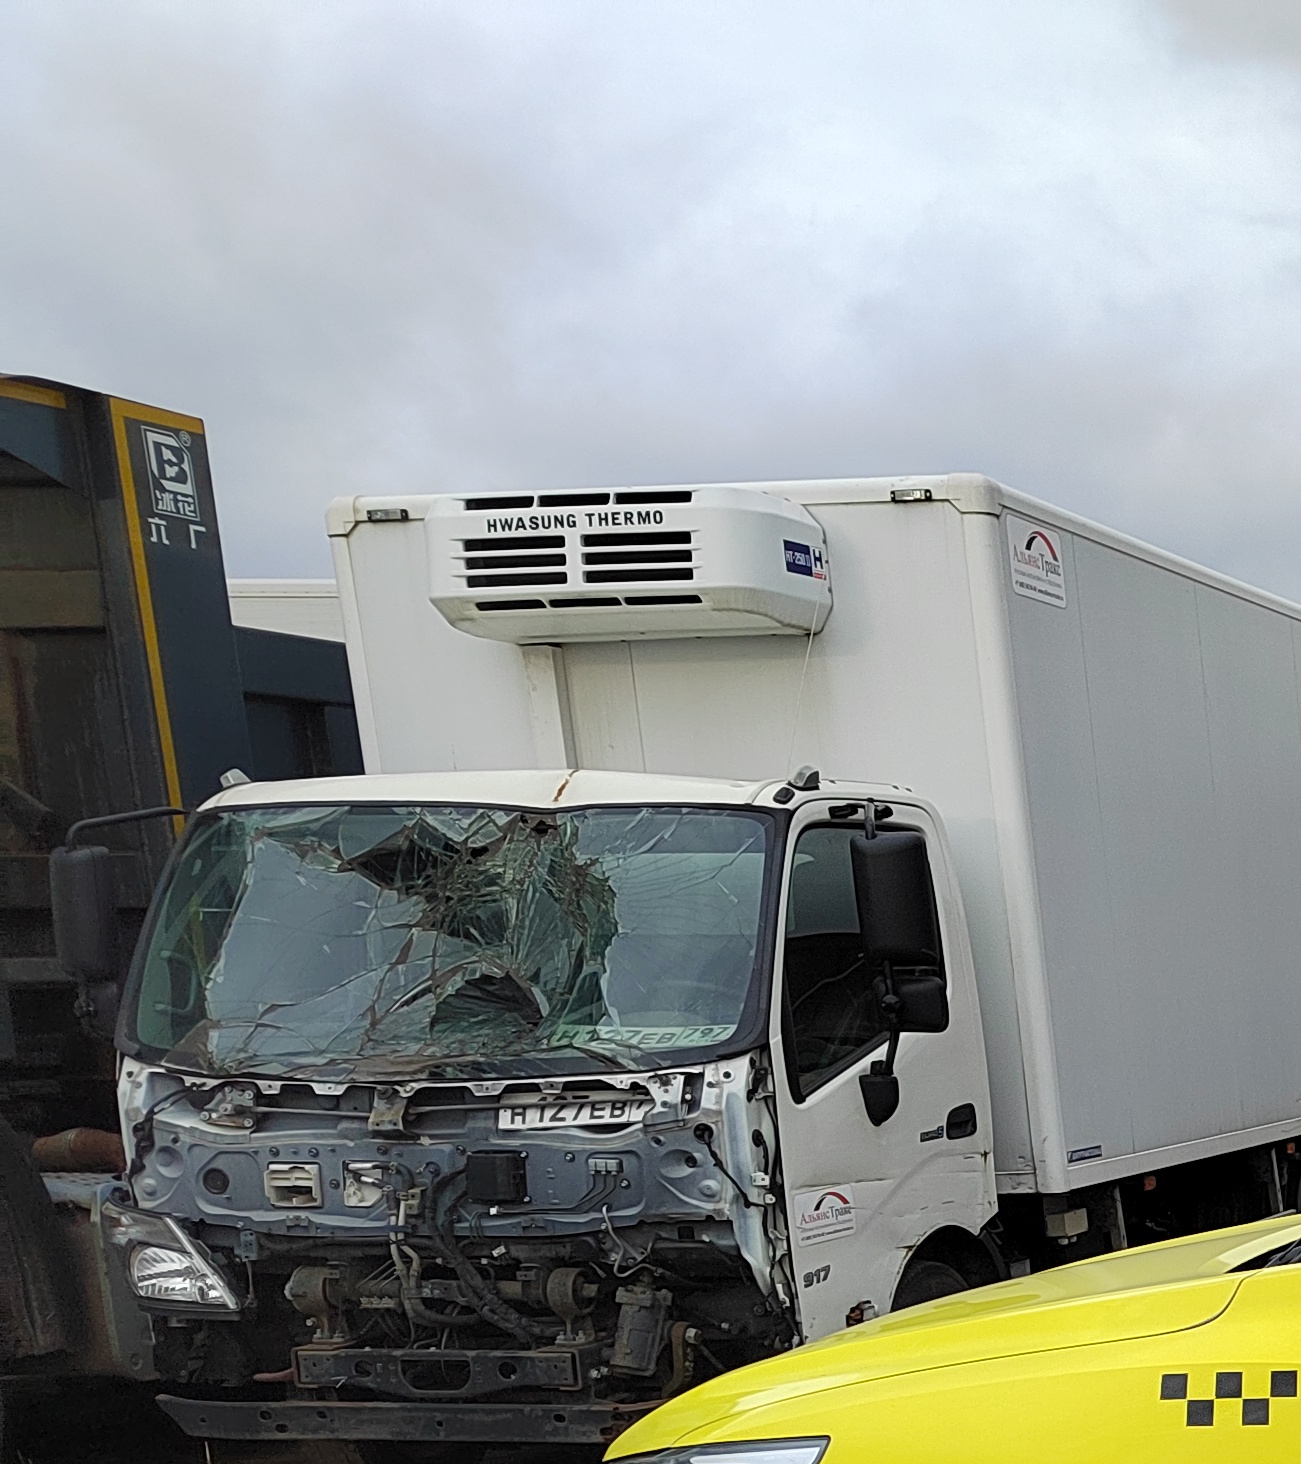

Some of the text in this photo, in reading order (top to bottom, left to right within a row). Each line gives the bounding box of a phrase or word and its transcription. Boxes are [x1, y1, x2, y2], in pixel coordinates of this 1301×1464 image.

[486, 509, 664, 533] HWASUNG THERMO
[802, 1264, 831, 1289] 917
